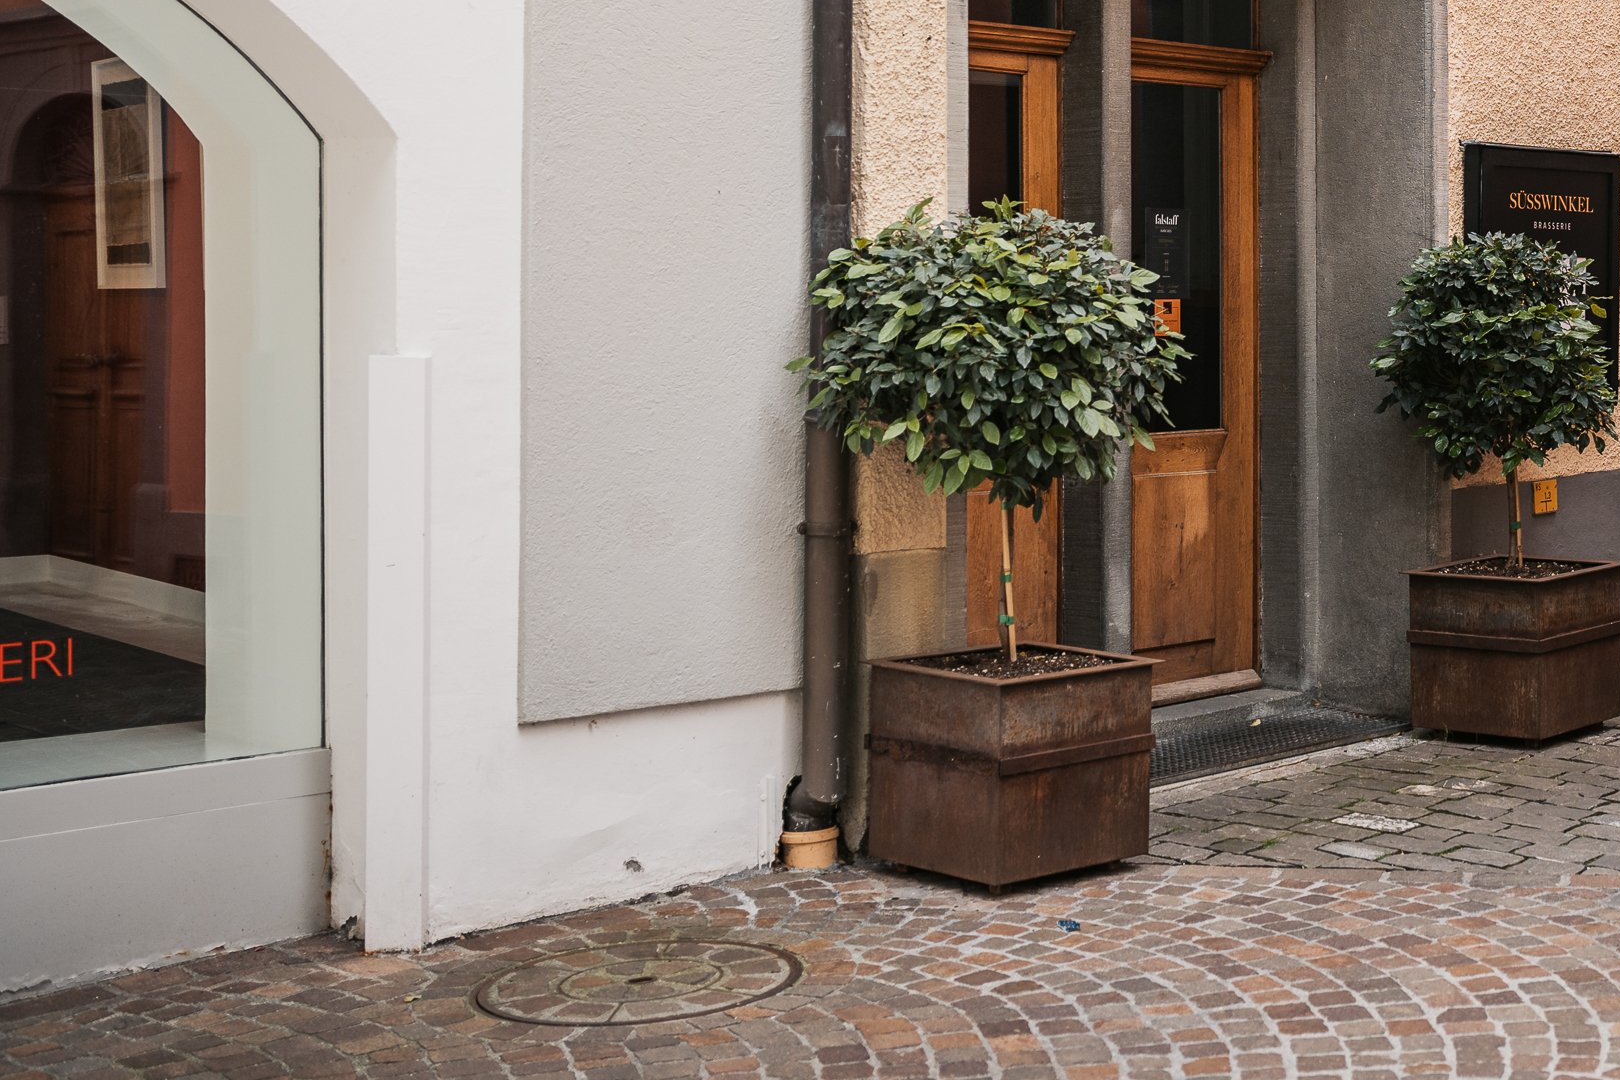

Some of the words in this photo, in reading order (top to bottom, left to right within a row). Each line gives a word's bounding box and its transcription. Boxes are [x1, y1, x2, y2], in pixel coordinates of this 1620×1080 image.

[1509, 190, 1594, 214] SÜSSWINKEL
[1155, 213, 1180, 226] falstaff
[1533, 221, 1572, 231] BRASSERIE
[0, 637, 74, 683] ERI
